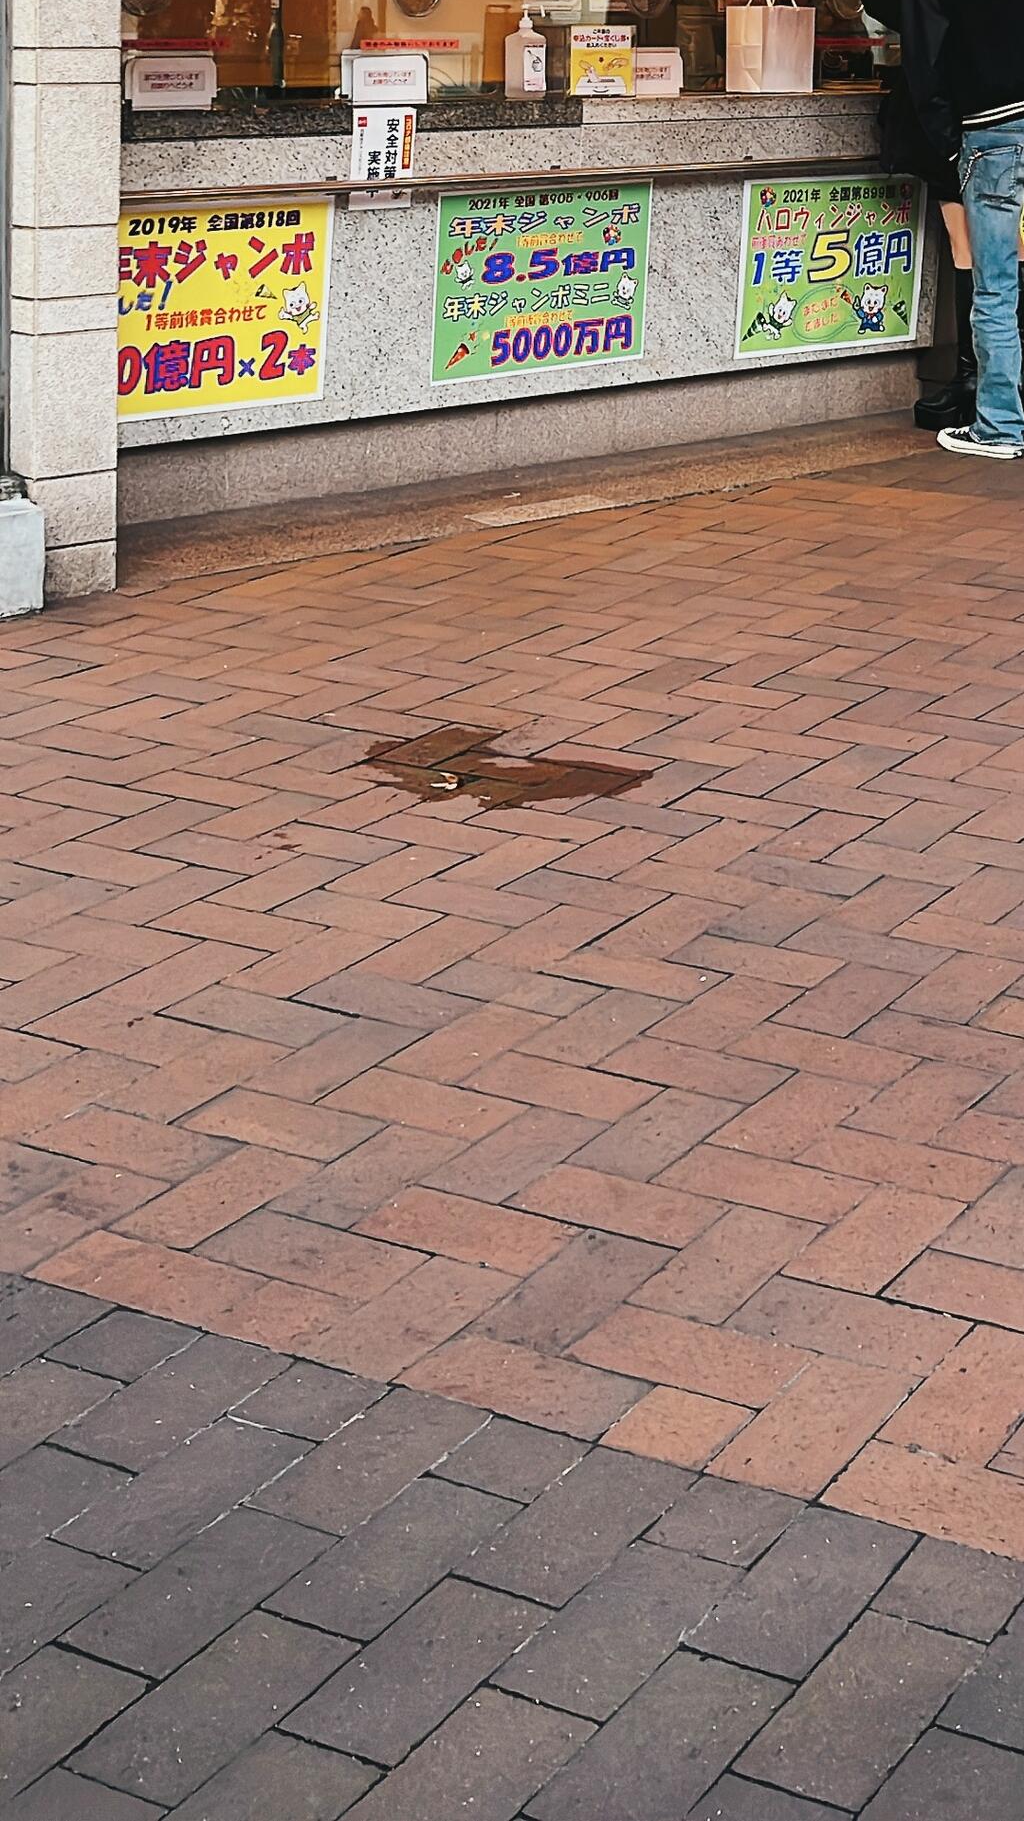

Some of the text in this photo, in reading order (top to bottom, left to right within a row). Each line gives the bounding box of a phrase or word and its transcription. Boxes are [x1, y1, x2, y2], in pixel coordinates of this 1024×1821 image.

[469, 198, 509, 211] 2021年
[783, 189, 821, 203] 2021年
[129, 210, 300, 236] 2019年 全国第818回
[449, 203, 640, 238] 年末ジャンボ
[756, 202, 912, 233] ハロウィンジャンボ
[481, 247, 636, 285] 8.5億円
[443, 283, 610, 321] 年末ジャンボミニ
[490, 314, 634, 367] 5000万円
